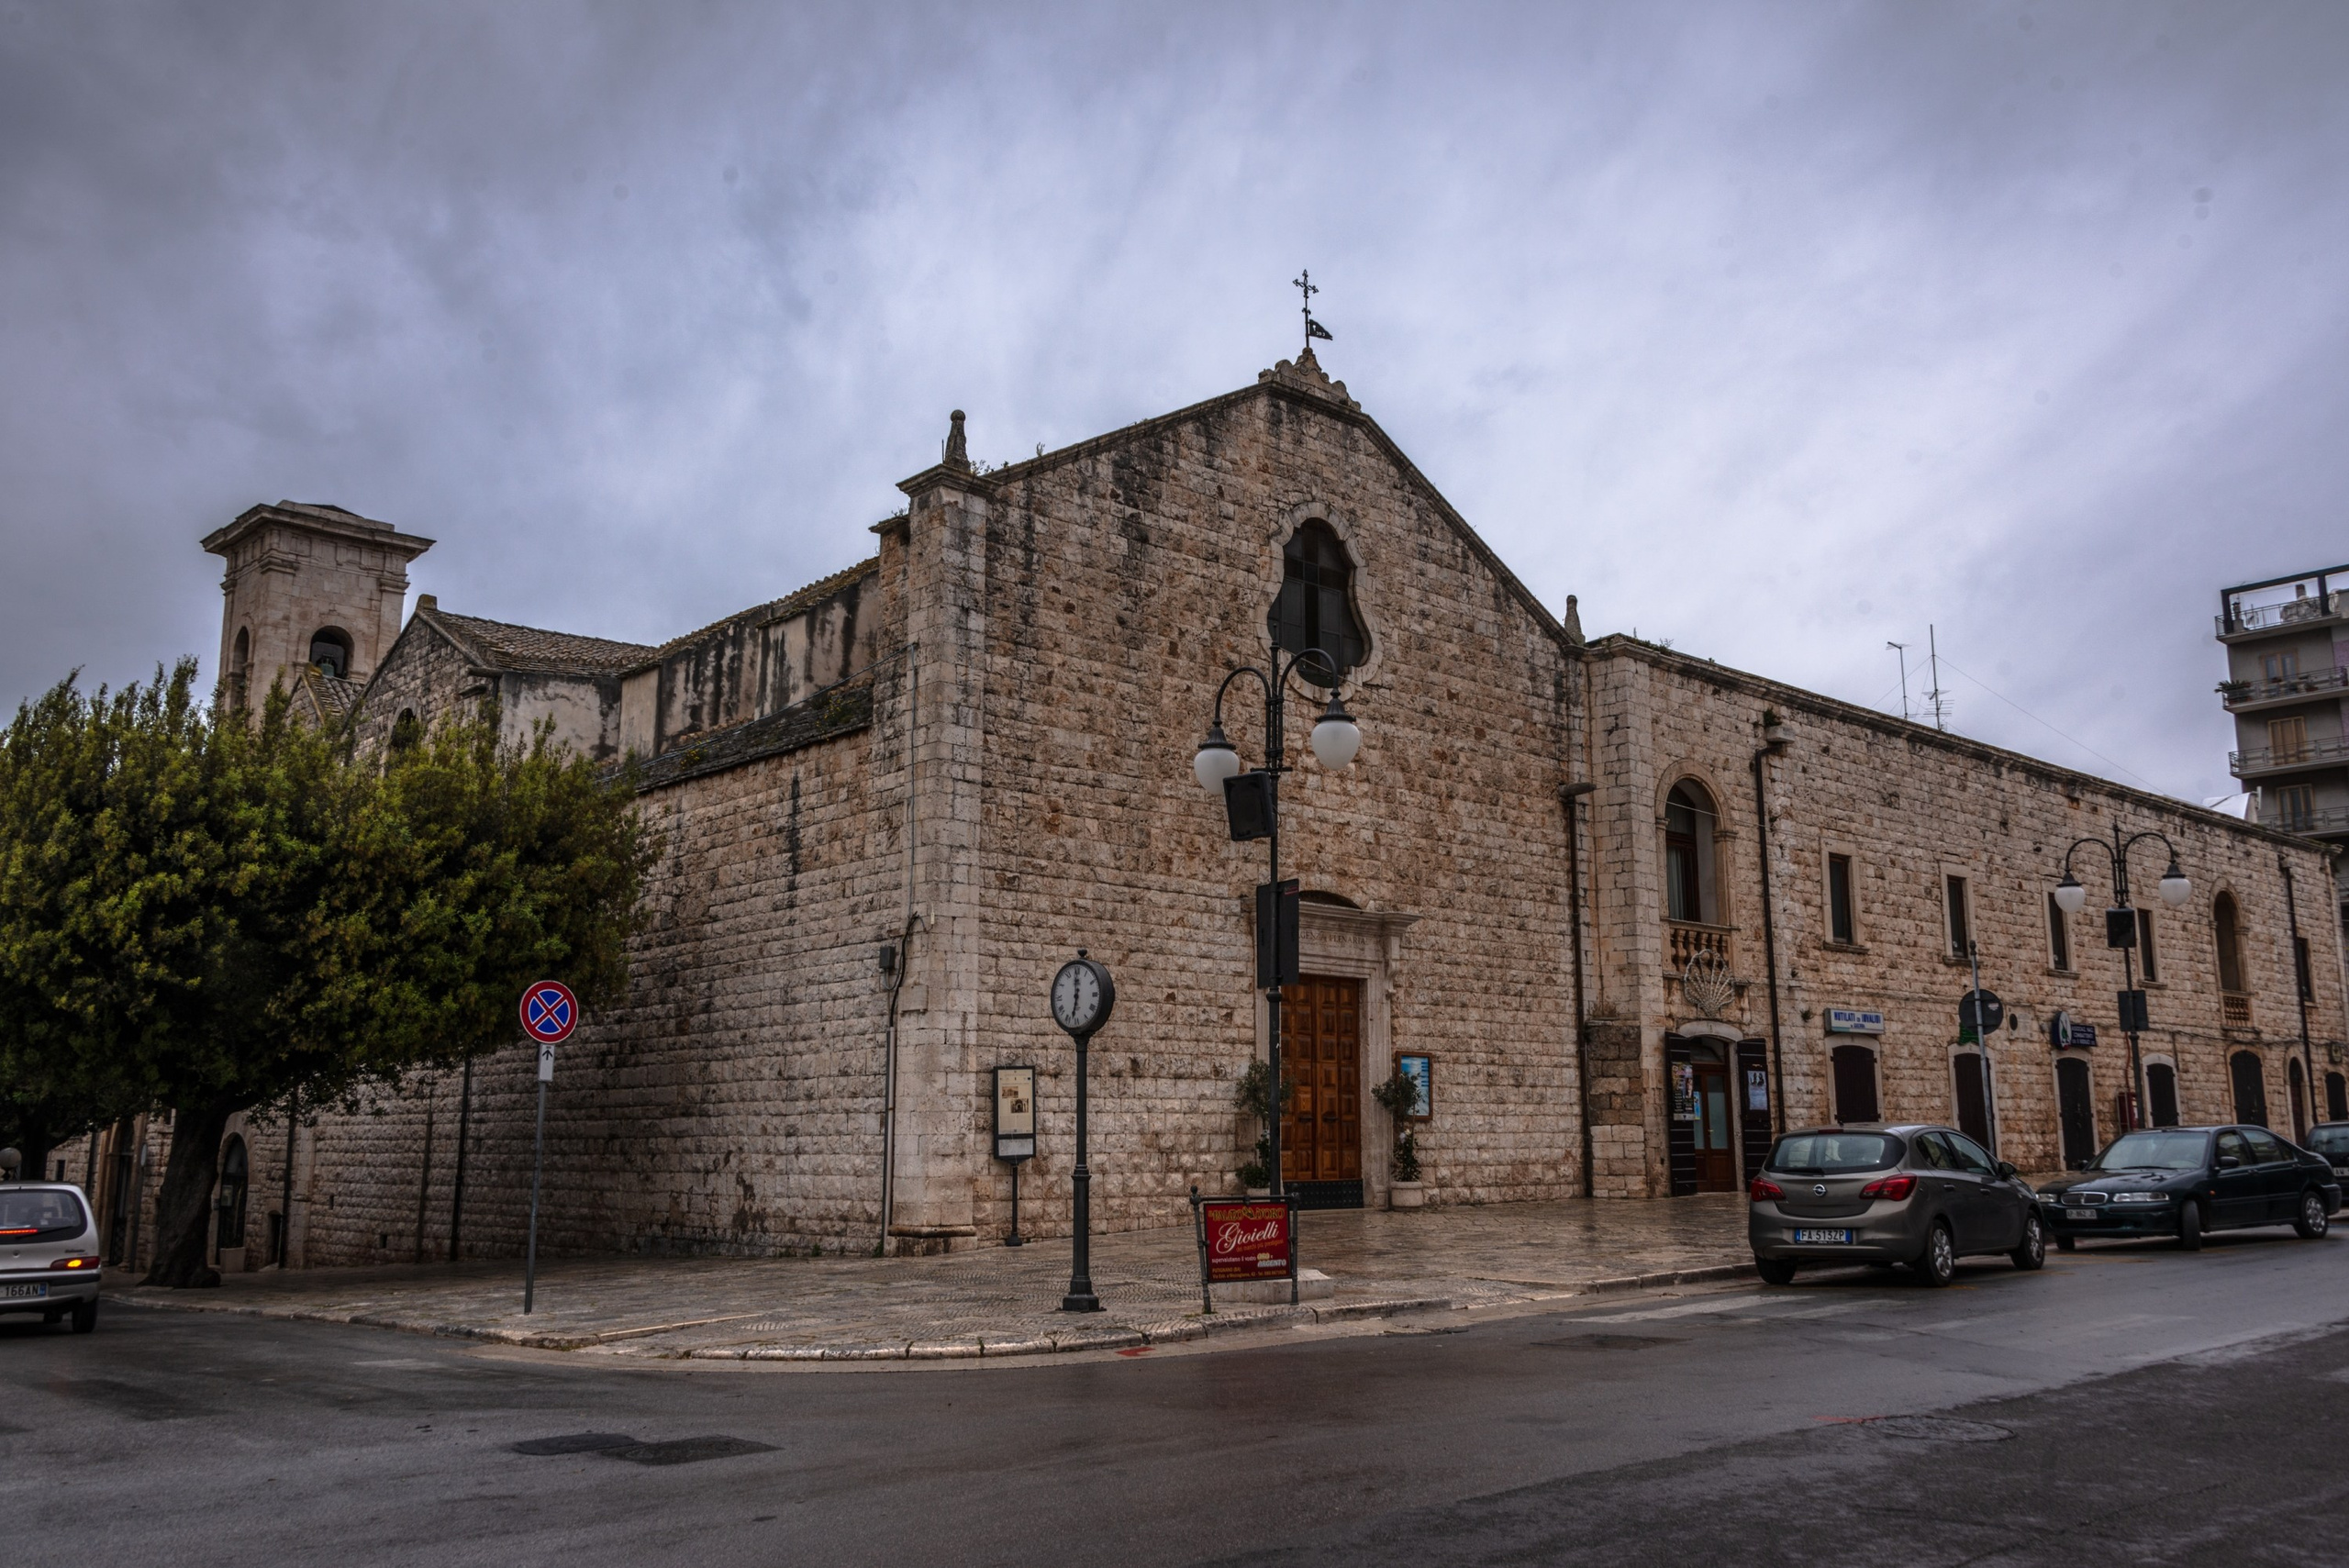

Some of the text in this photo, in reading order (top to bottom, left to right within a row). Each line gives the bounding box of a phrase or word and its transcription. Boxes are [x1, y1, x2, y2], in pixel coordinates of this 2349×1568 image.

[1216, 1221, 1279, 1254] Gioielli
[1801, 1229, 1844, 1240] FA 513ZP
[1257, 1259, 1287, 1268] ARGENTO
[6, 1284, 39, 1296] 166AN
